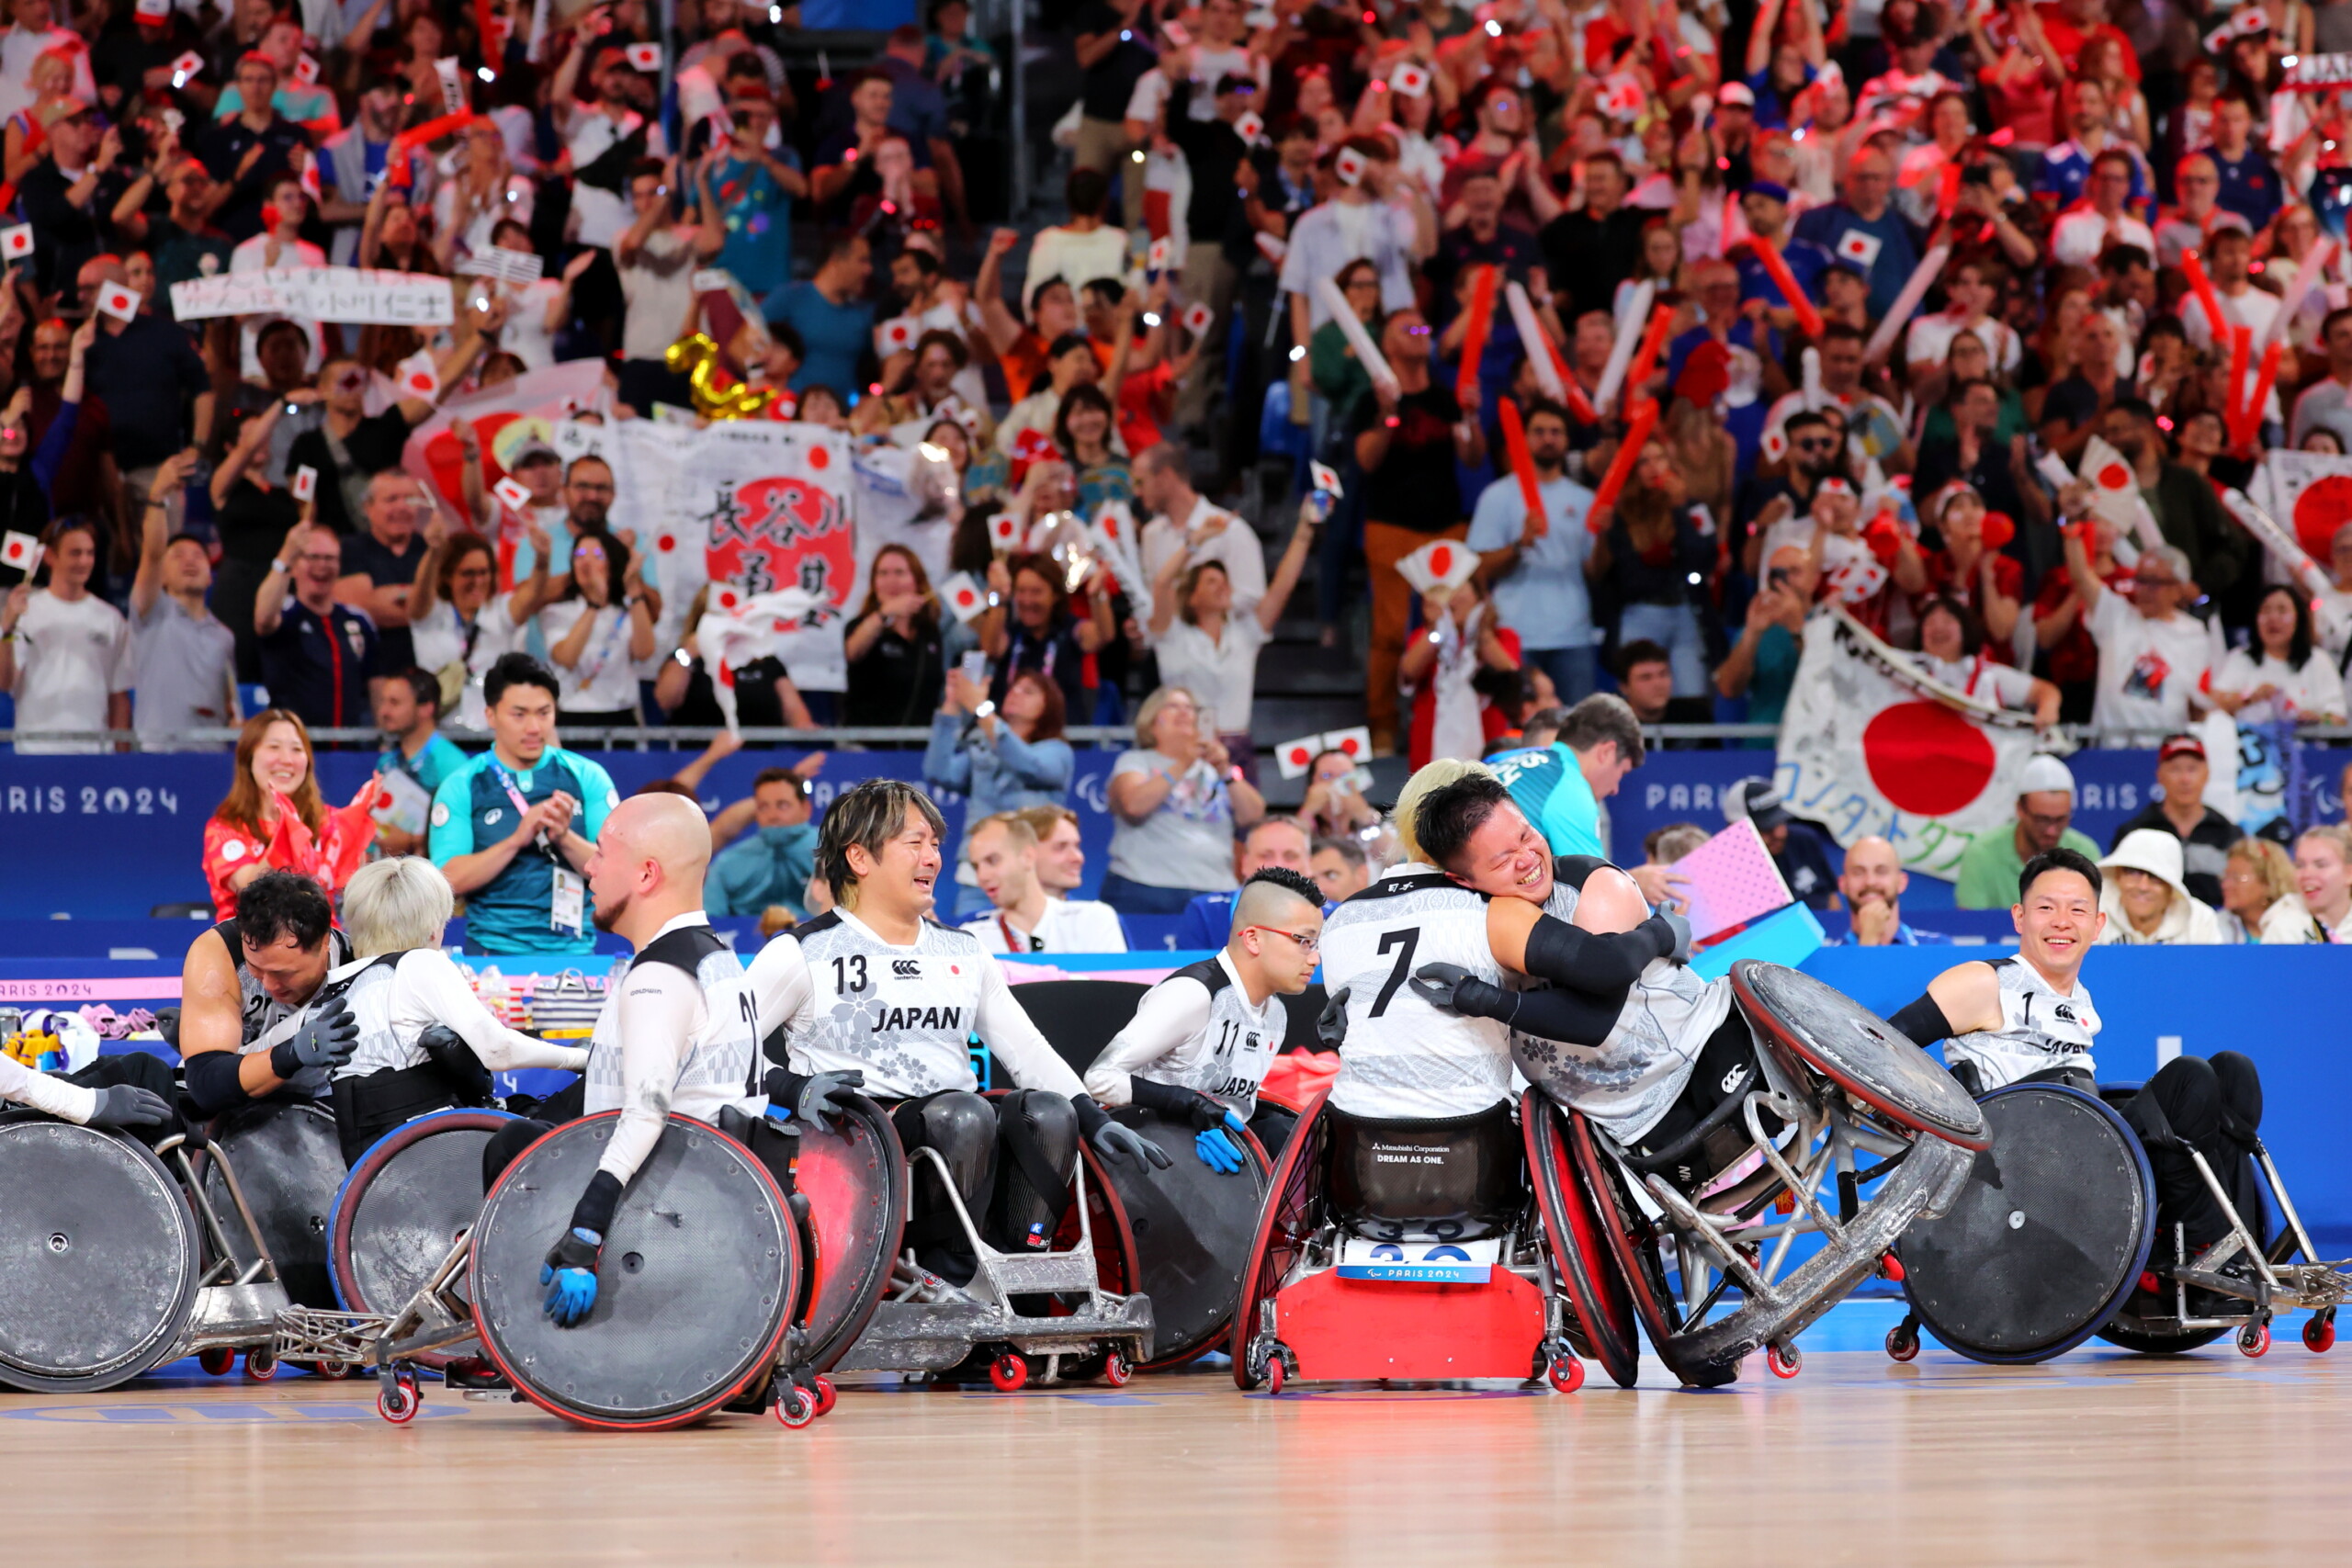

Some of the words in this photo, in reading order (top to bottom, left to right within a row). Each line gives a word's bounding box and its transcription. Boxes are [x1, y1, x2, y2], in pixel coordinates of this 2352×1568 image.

[696, 479, 847, 547] 長谷川
[0, 785, 66, 814] RIS
[80, 785, 177, 815] 2024
[1645, 783, 1728, 811] PARI
[831, 954, 868, 995] 13
[1367, 926, 1420, 1019] 7
[45, 984, 92, 997] 2024
[871, 1006, 961, 1033] JAPAN
[2021, 991, 2035, 1026] 1
[1215, 1019, 1240, 1058] 11
[1377, 1155, 1408, 1163] DREAM
[1409, 1156, 1421, 1164] AS
[1423, 1156, 1444, 1165] ONE.
[1381, 1144, 1413, 1152] Mitsubishi
[1413, 1145, 1451, 1154] Corporation
[1387, 1269, 1423, 1278] PARIS
[1427, 1269, 1460, 1279] 2024
